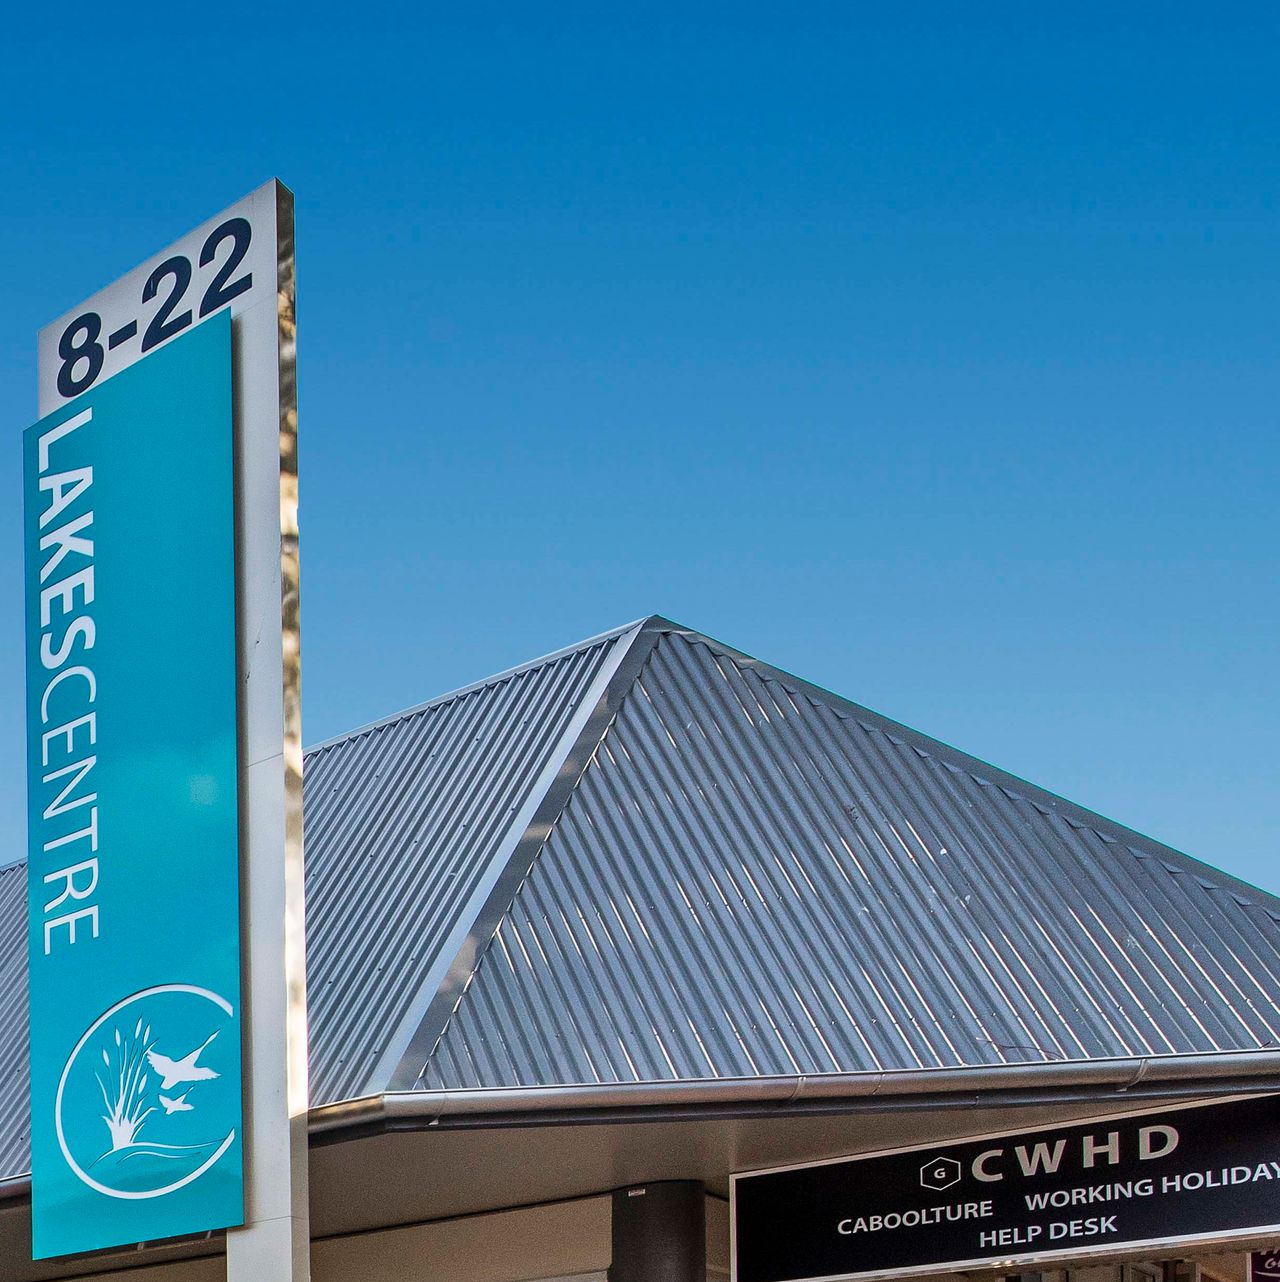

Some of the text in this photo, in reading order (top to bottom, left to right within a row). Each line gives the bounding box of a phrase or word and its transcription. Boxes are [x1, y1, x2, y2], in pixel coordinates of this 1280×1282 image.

[56, 217, 253, 398] 8-22
[837, 1200, 994, 1236] CABOOLTURE
[1024, 1178, 1154, 1212] WORKING
[979, 1215, 1119, 1248] HELP DESK
